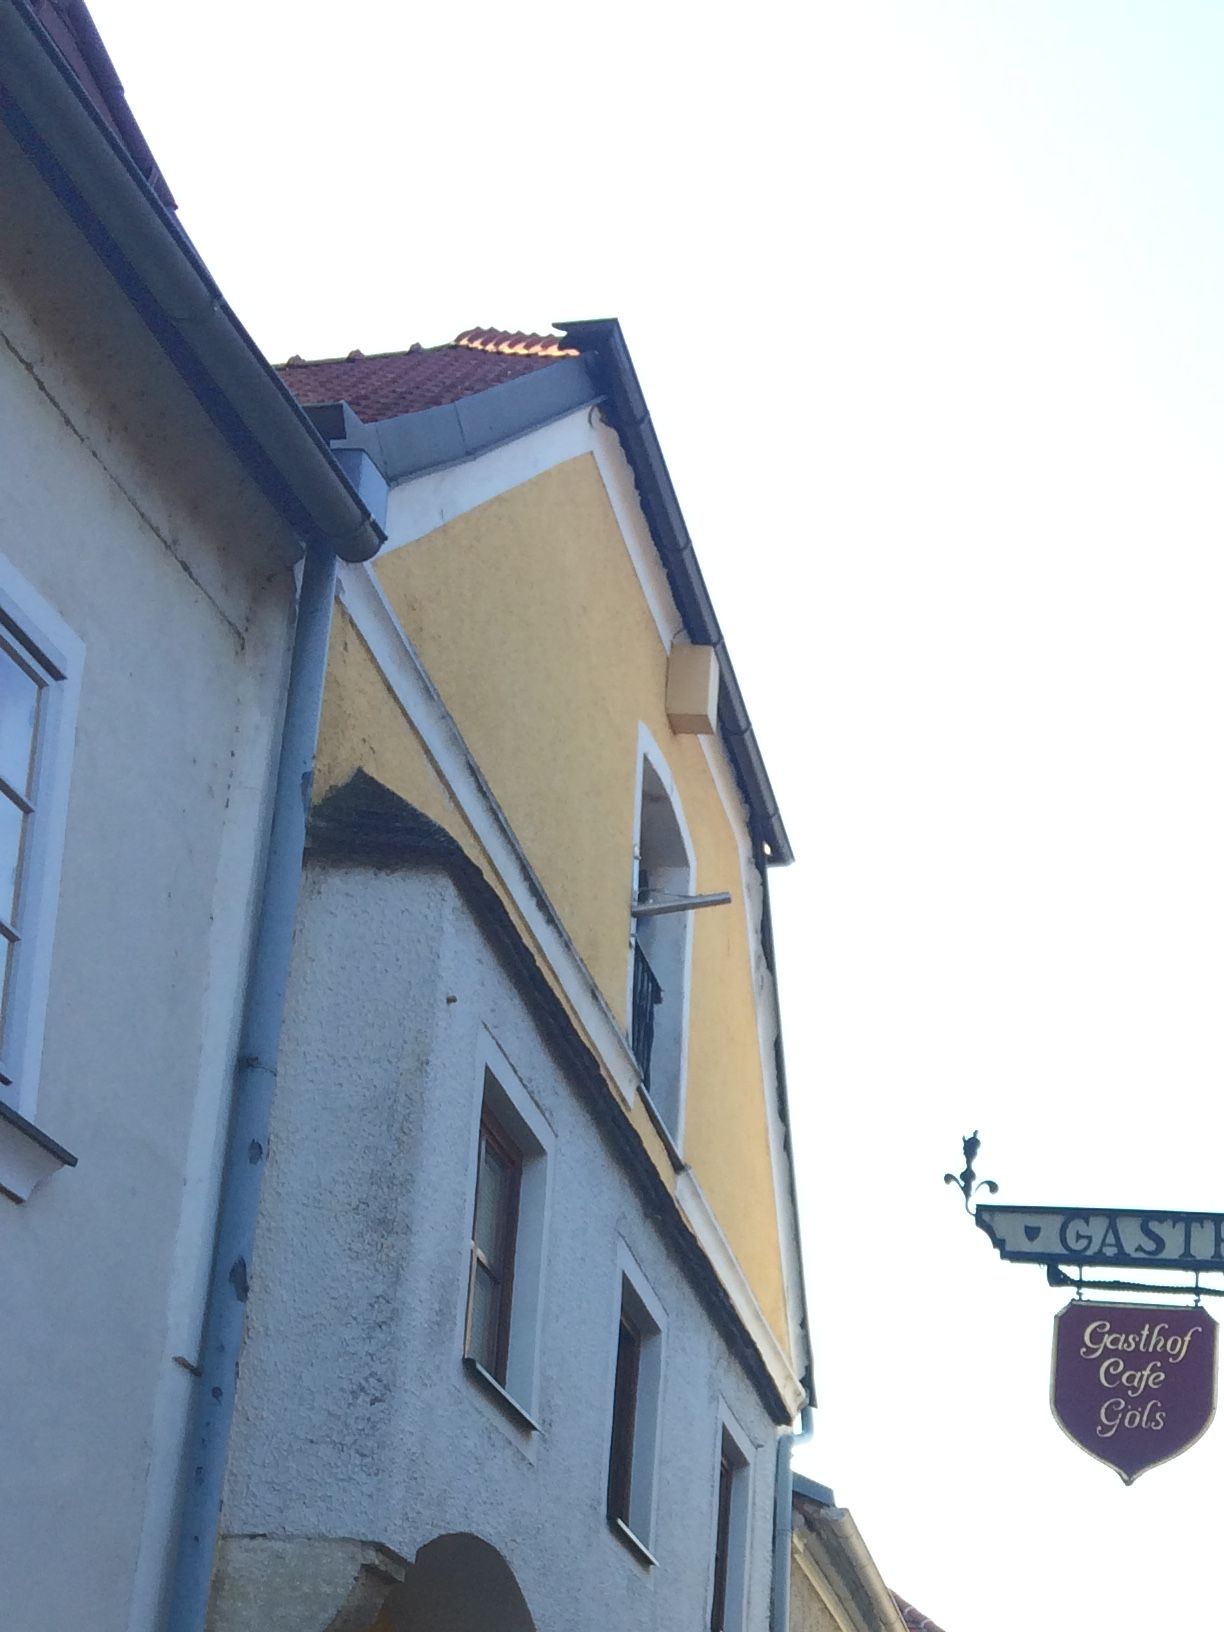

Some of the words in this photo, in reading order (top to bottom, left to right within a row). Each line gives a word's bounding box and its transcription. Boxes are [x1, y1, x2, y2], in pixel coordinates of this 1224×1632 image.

[1080, 1320, 1203, 1363] Gasthof
[1099, 1358, 1166, 1397] Cafe
[1097, 1398, 1167, 1437] Göls
